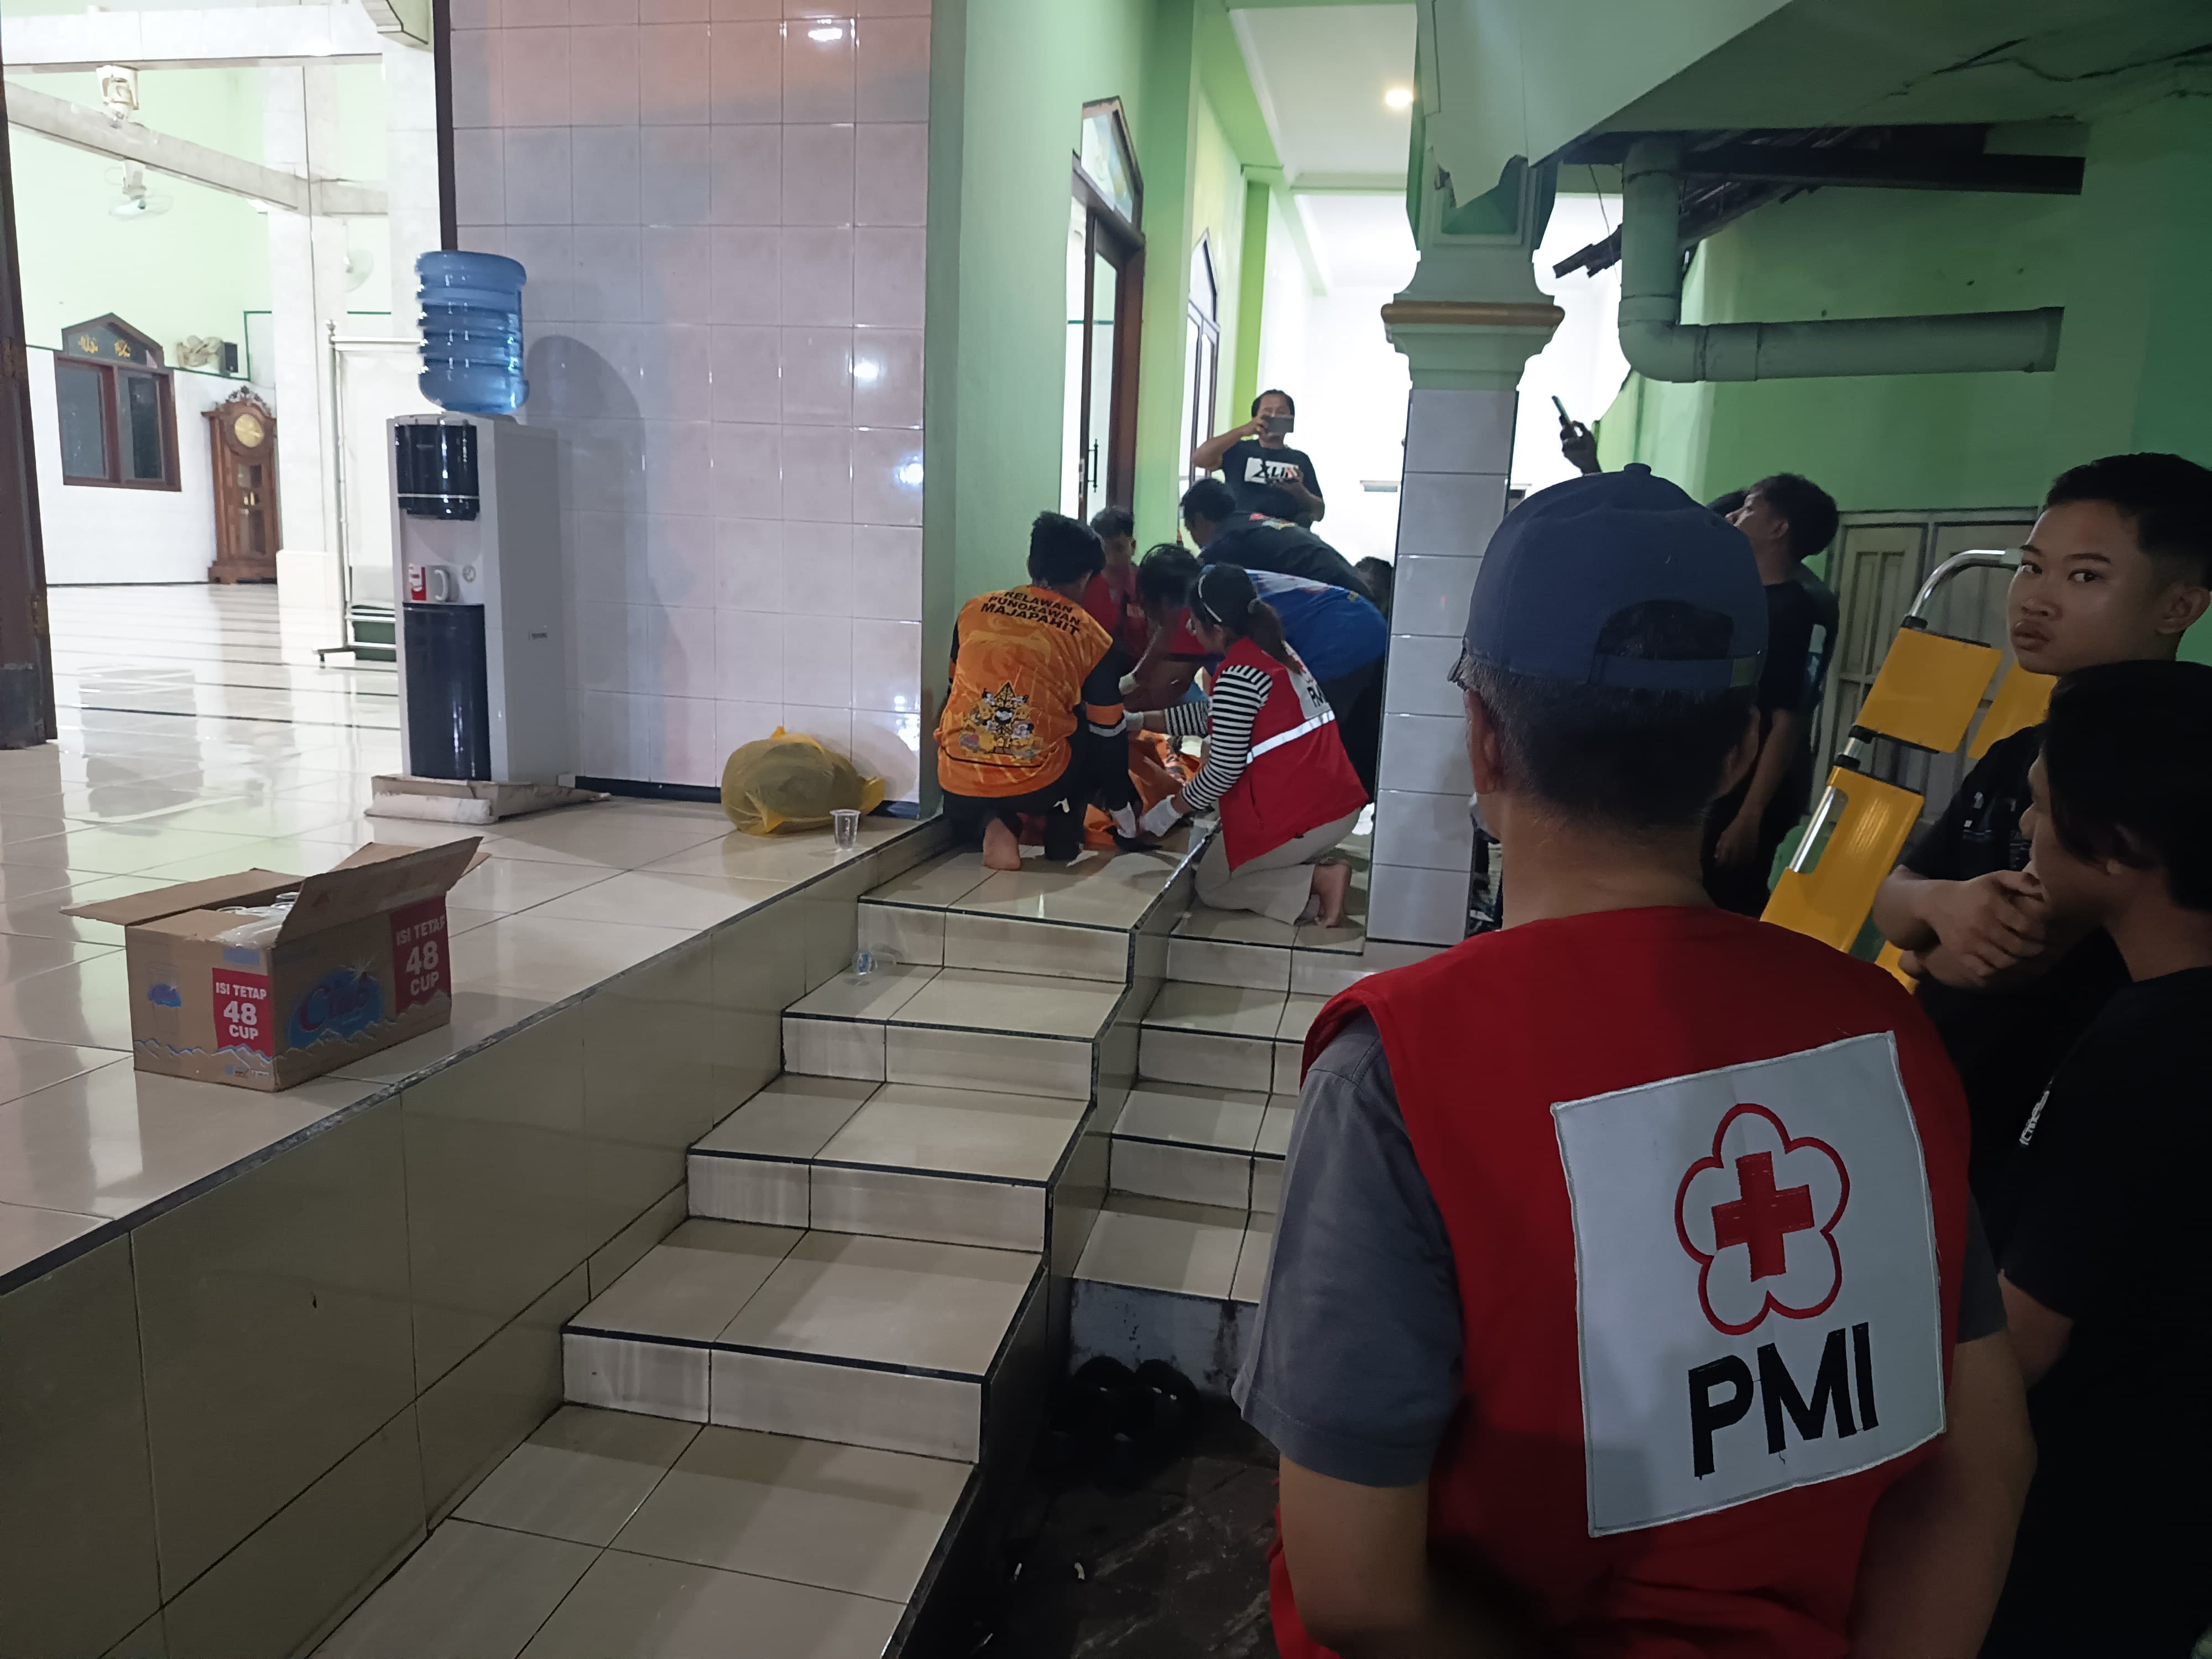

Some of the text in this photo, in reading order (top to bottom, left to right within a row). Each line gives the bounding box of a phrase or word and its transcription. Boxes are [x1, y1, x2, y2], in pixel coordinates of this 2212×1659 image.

[989, 596, 1080, 625] PUNOKAWAN
[1004, 592, 1073, 613] RELAWAN
[980, 603, 1080, 635] MAJAPAHIT
[397, 915, 446, 946] ISI TETAP
[406, 941, 439, 975] 48
[216, 982, 267, 1000] ISI TETAP
[410, 972, 439, 996] CUP
[223, 1000, 257, 1025] 48
[229, 1025, 259, 1040] CUP
[1688, 1322, 1879, 1478] PMI
